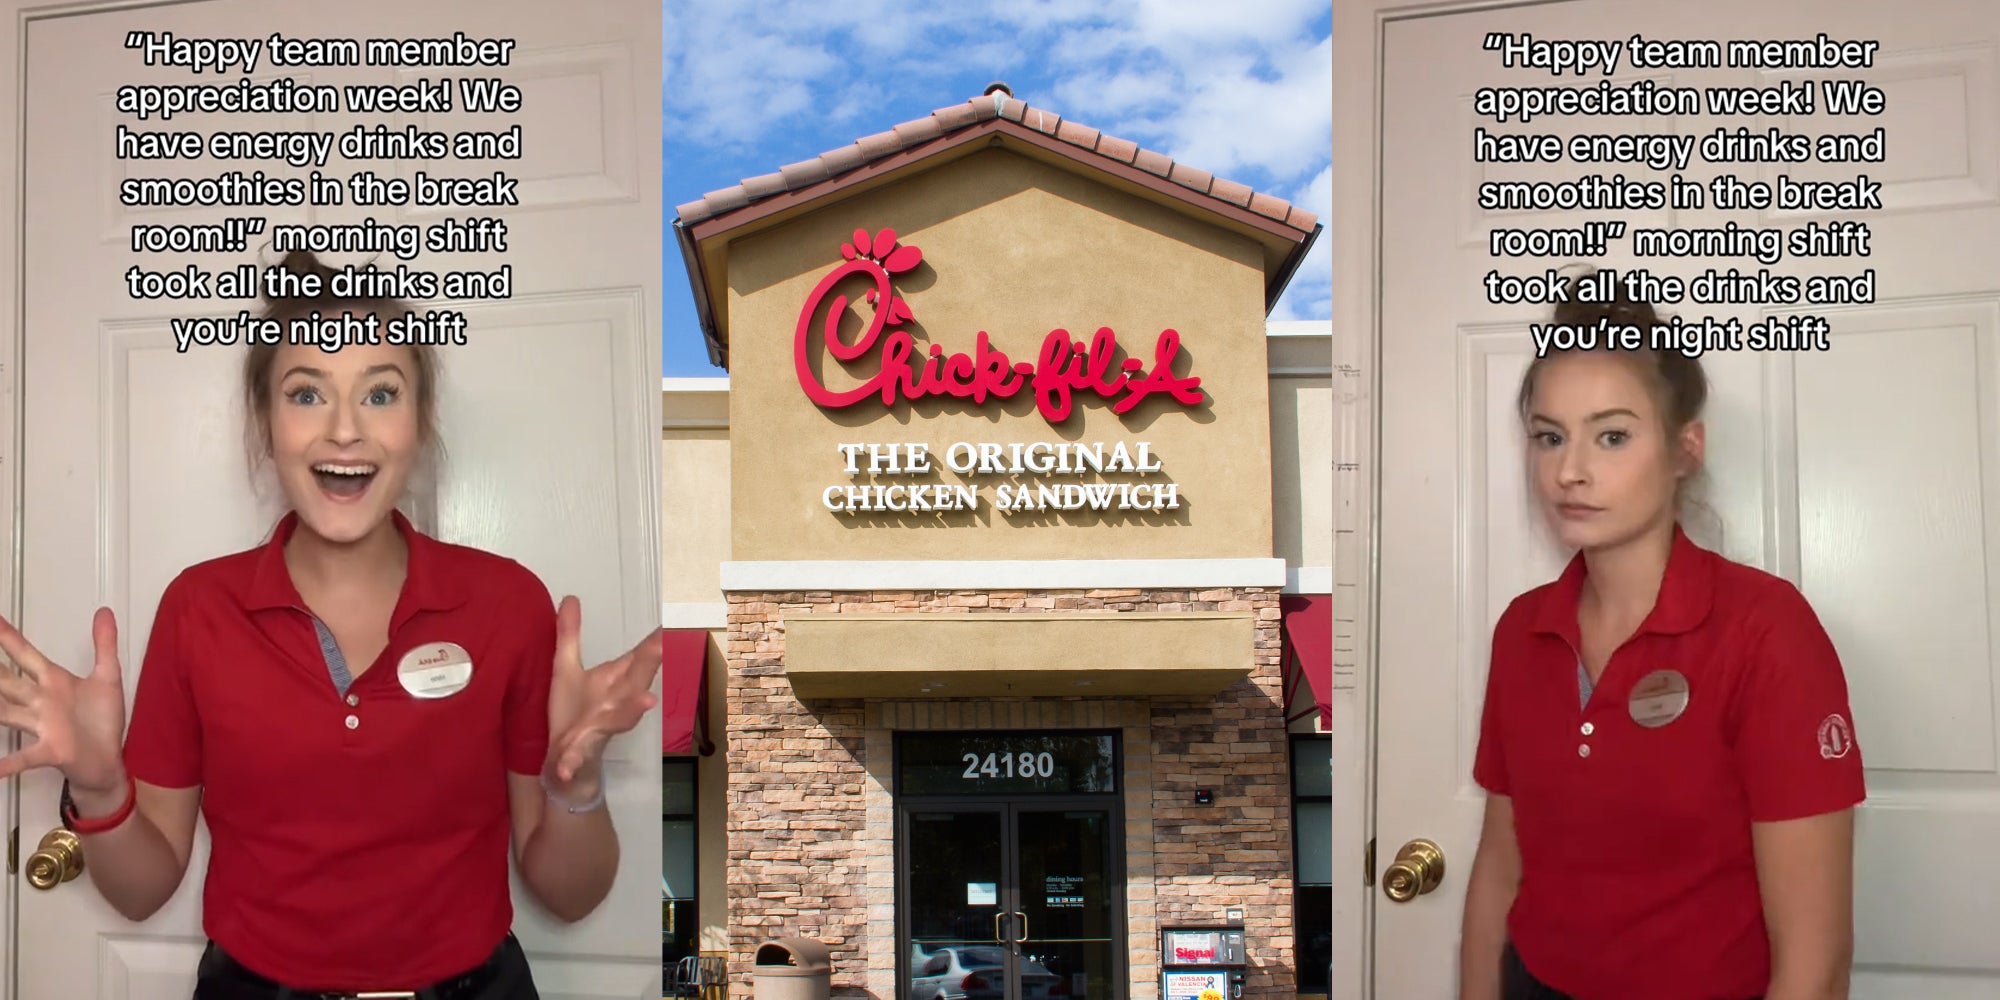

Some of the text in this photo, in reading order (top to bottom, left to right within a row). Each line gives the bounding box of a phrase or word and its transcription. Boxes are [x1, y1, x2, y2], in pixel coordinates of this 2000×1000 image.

[794, 228, 1204, 423] Chick-fil-A
[837, 441, 1162, 474] THE ORIGINAL
[822, 483, 1180, 512] CHICKEN SANDWICH
[962, 752, 1054, 779] 24180
[1176, 947, 1215, 960] Signal
